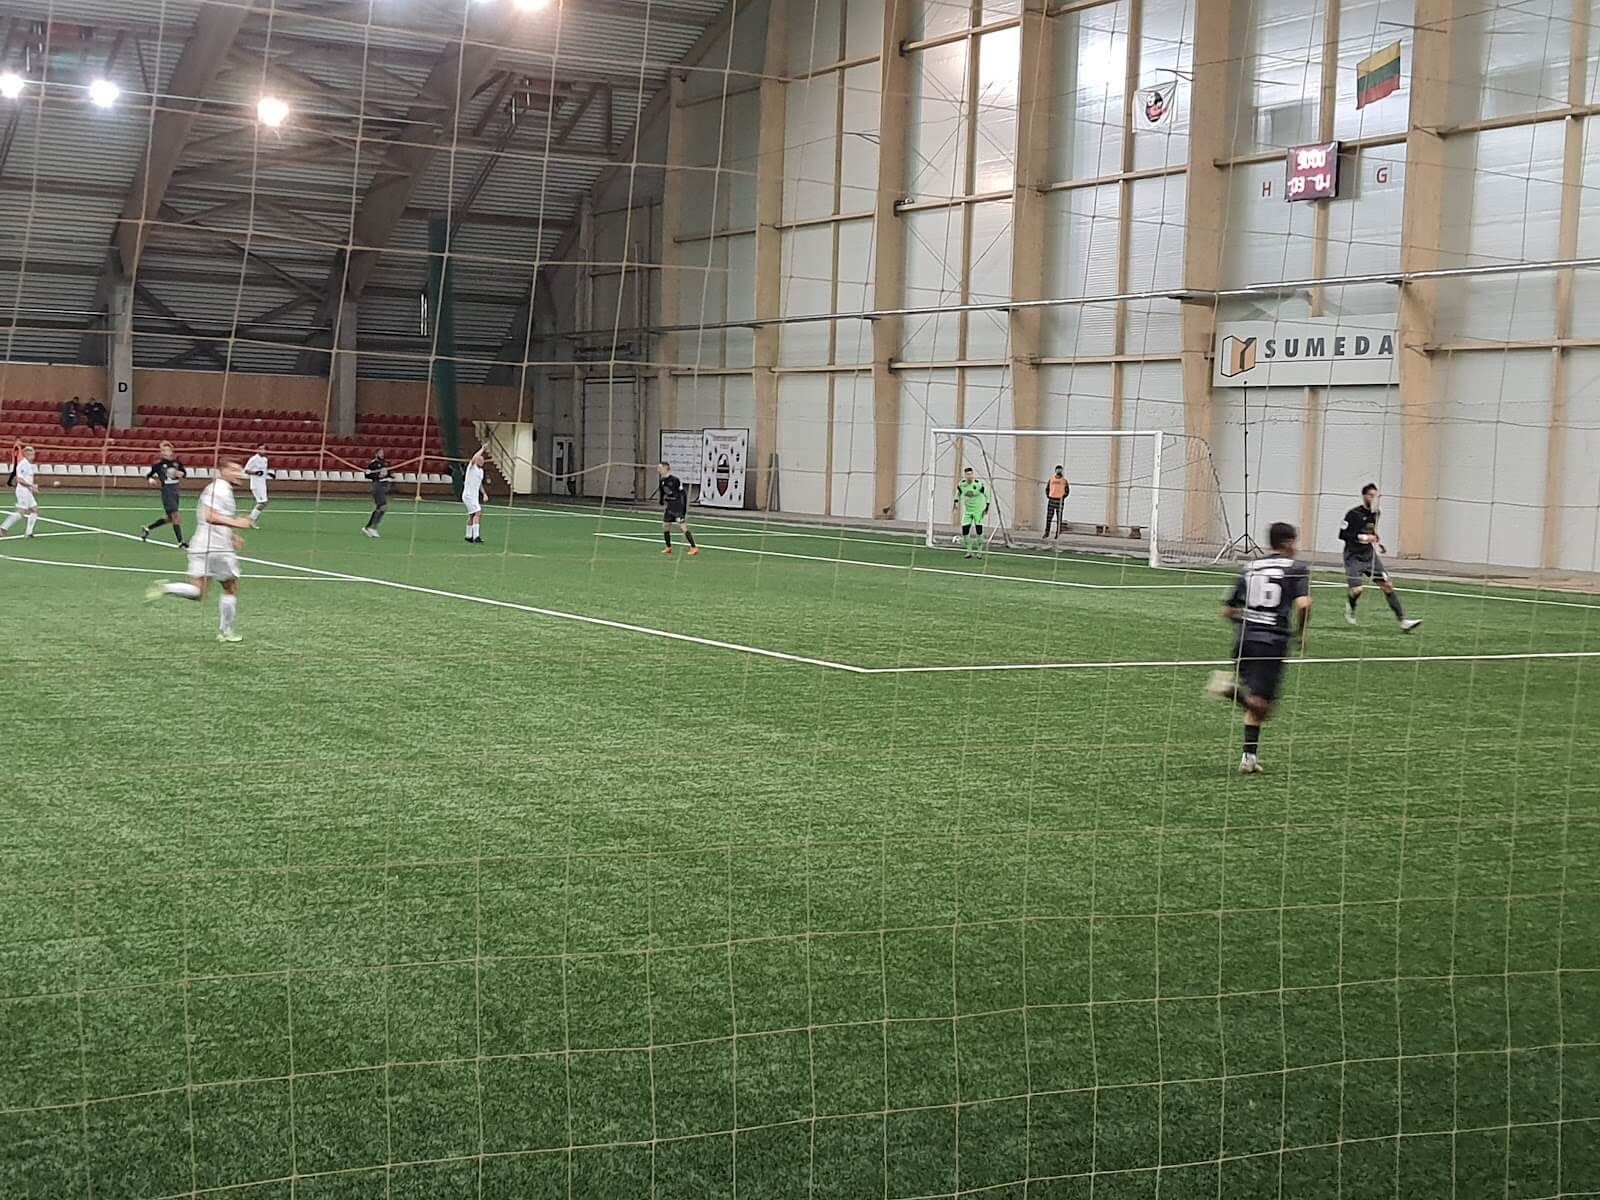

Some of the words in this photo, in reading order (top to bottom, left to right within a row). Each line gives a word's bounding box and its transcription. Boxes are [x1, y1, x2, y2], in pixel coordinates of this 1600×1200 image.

[1376, 167, 1388, 183] G
[1262, 181, 1271, 197] H
[1264, 335, 1394, 358] SUMEDA
[118, 382, 128, 393] D
[1245, 568, 1284, 608] 16
